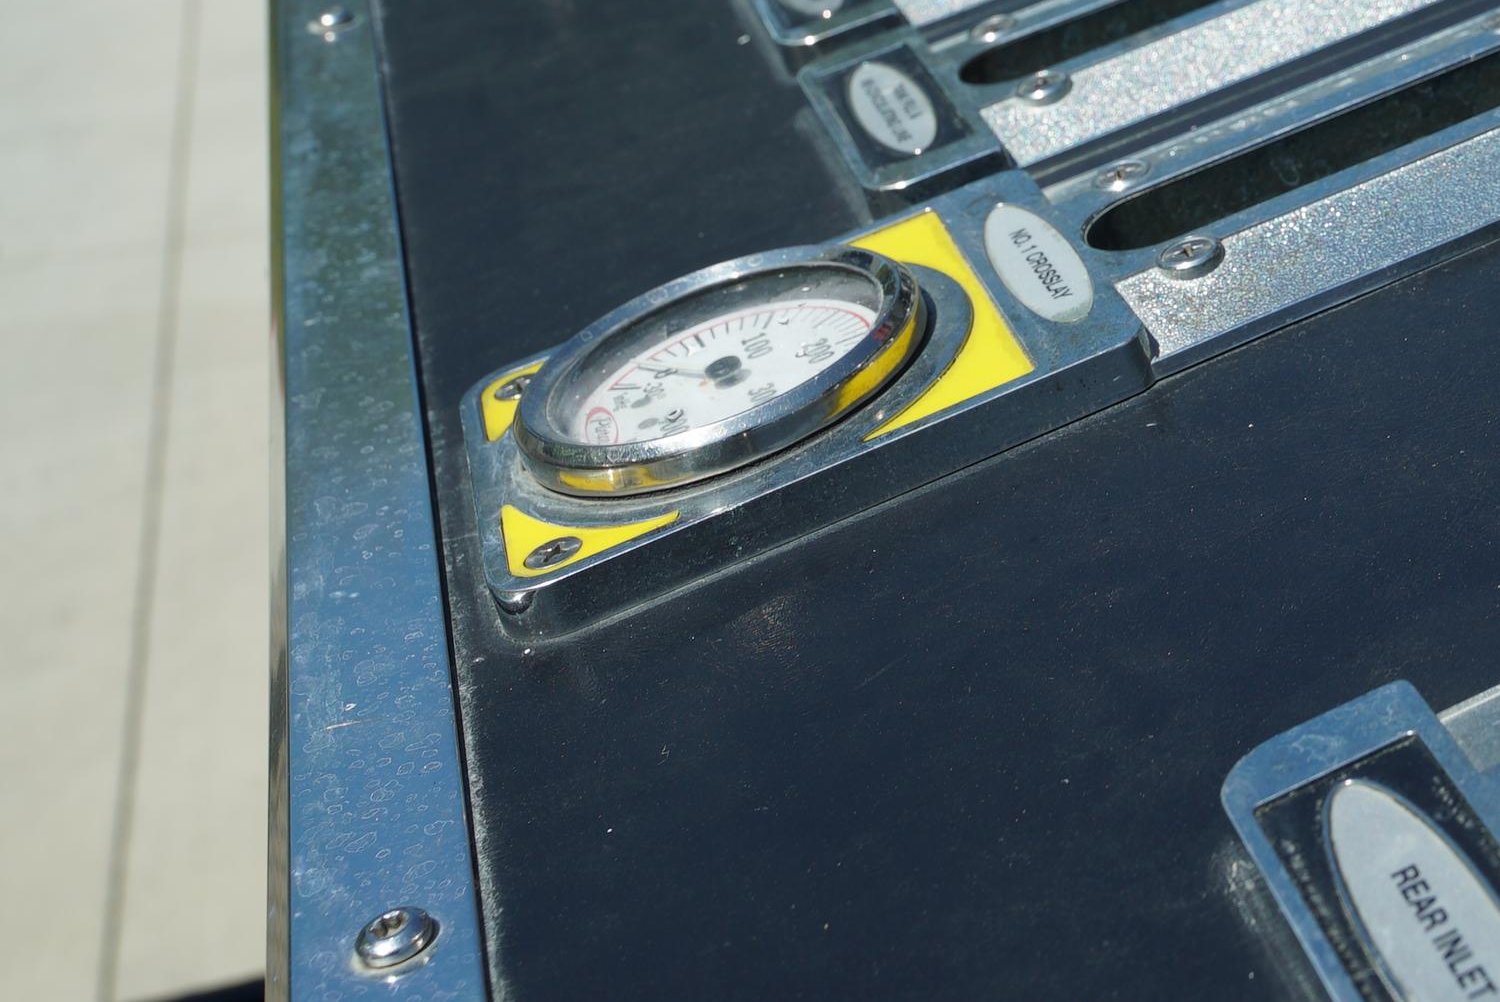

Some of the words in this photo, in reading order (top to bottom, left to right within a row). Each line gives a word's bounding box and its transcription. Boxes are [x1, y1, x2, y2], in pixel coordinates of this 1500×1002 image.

[1008, 227, 1032, 248] NO.
[1021, 245, 1037, 254] 1
[1026, 251, 1074, 299] CROSSLAY
[741, 332, 773, 360] 100
[747, 382, 778, 403] 30
[1389, 862, 1449, 934] REAR
[1432, 927, 1499, 1002] INLET
